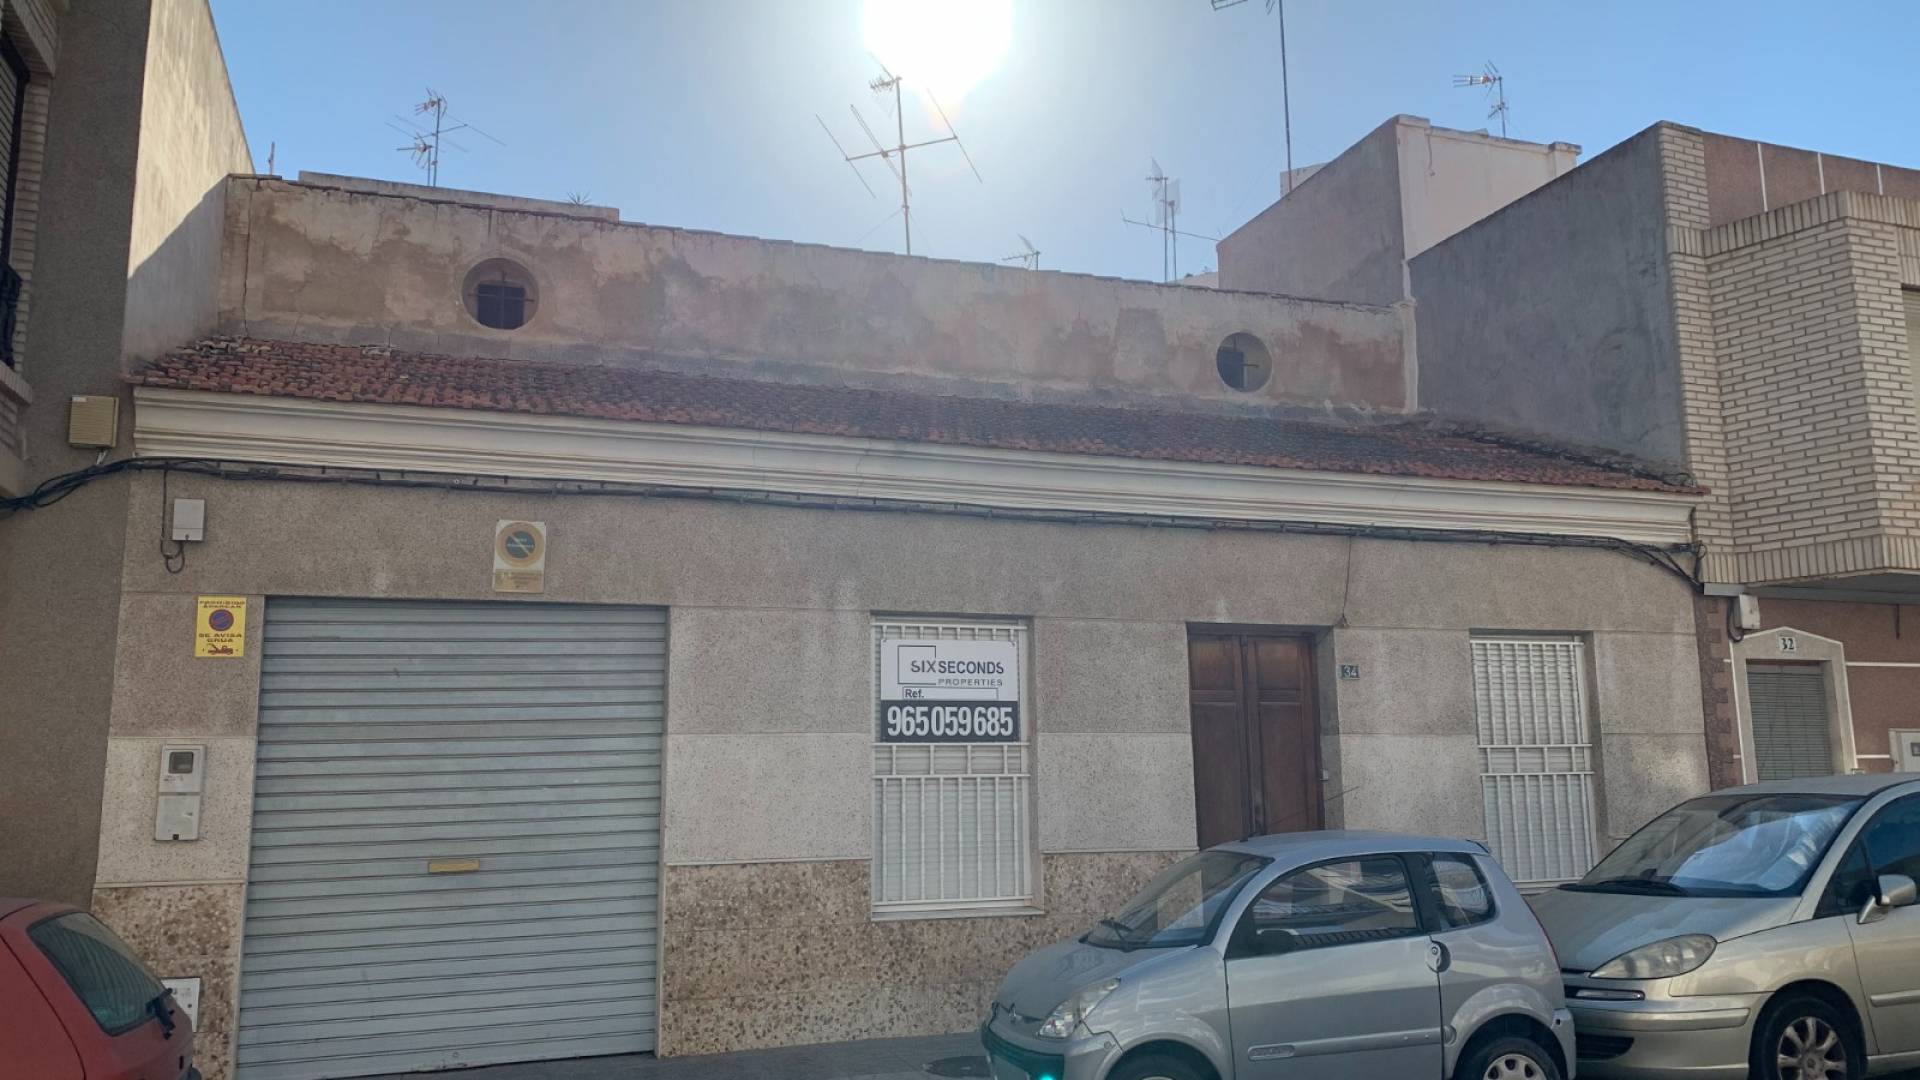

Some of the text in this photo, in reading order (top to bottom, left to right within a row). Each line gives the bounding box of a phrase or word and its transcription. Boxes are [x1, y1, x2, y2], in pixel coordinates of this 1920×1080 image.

[1781, 637, 1795, 650] 32
[1343, 665, 1358, 678] 34
[938, 678, 1003, 687] PROPERTIES
[904, 688, 925, 699] Ref.
